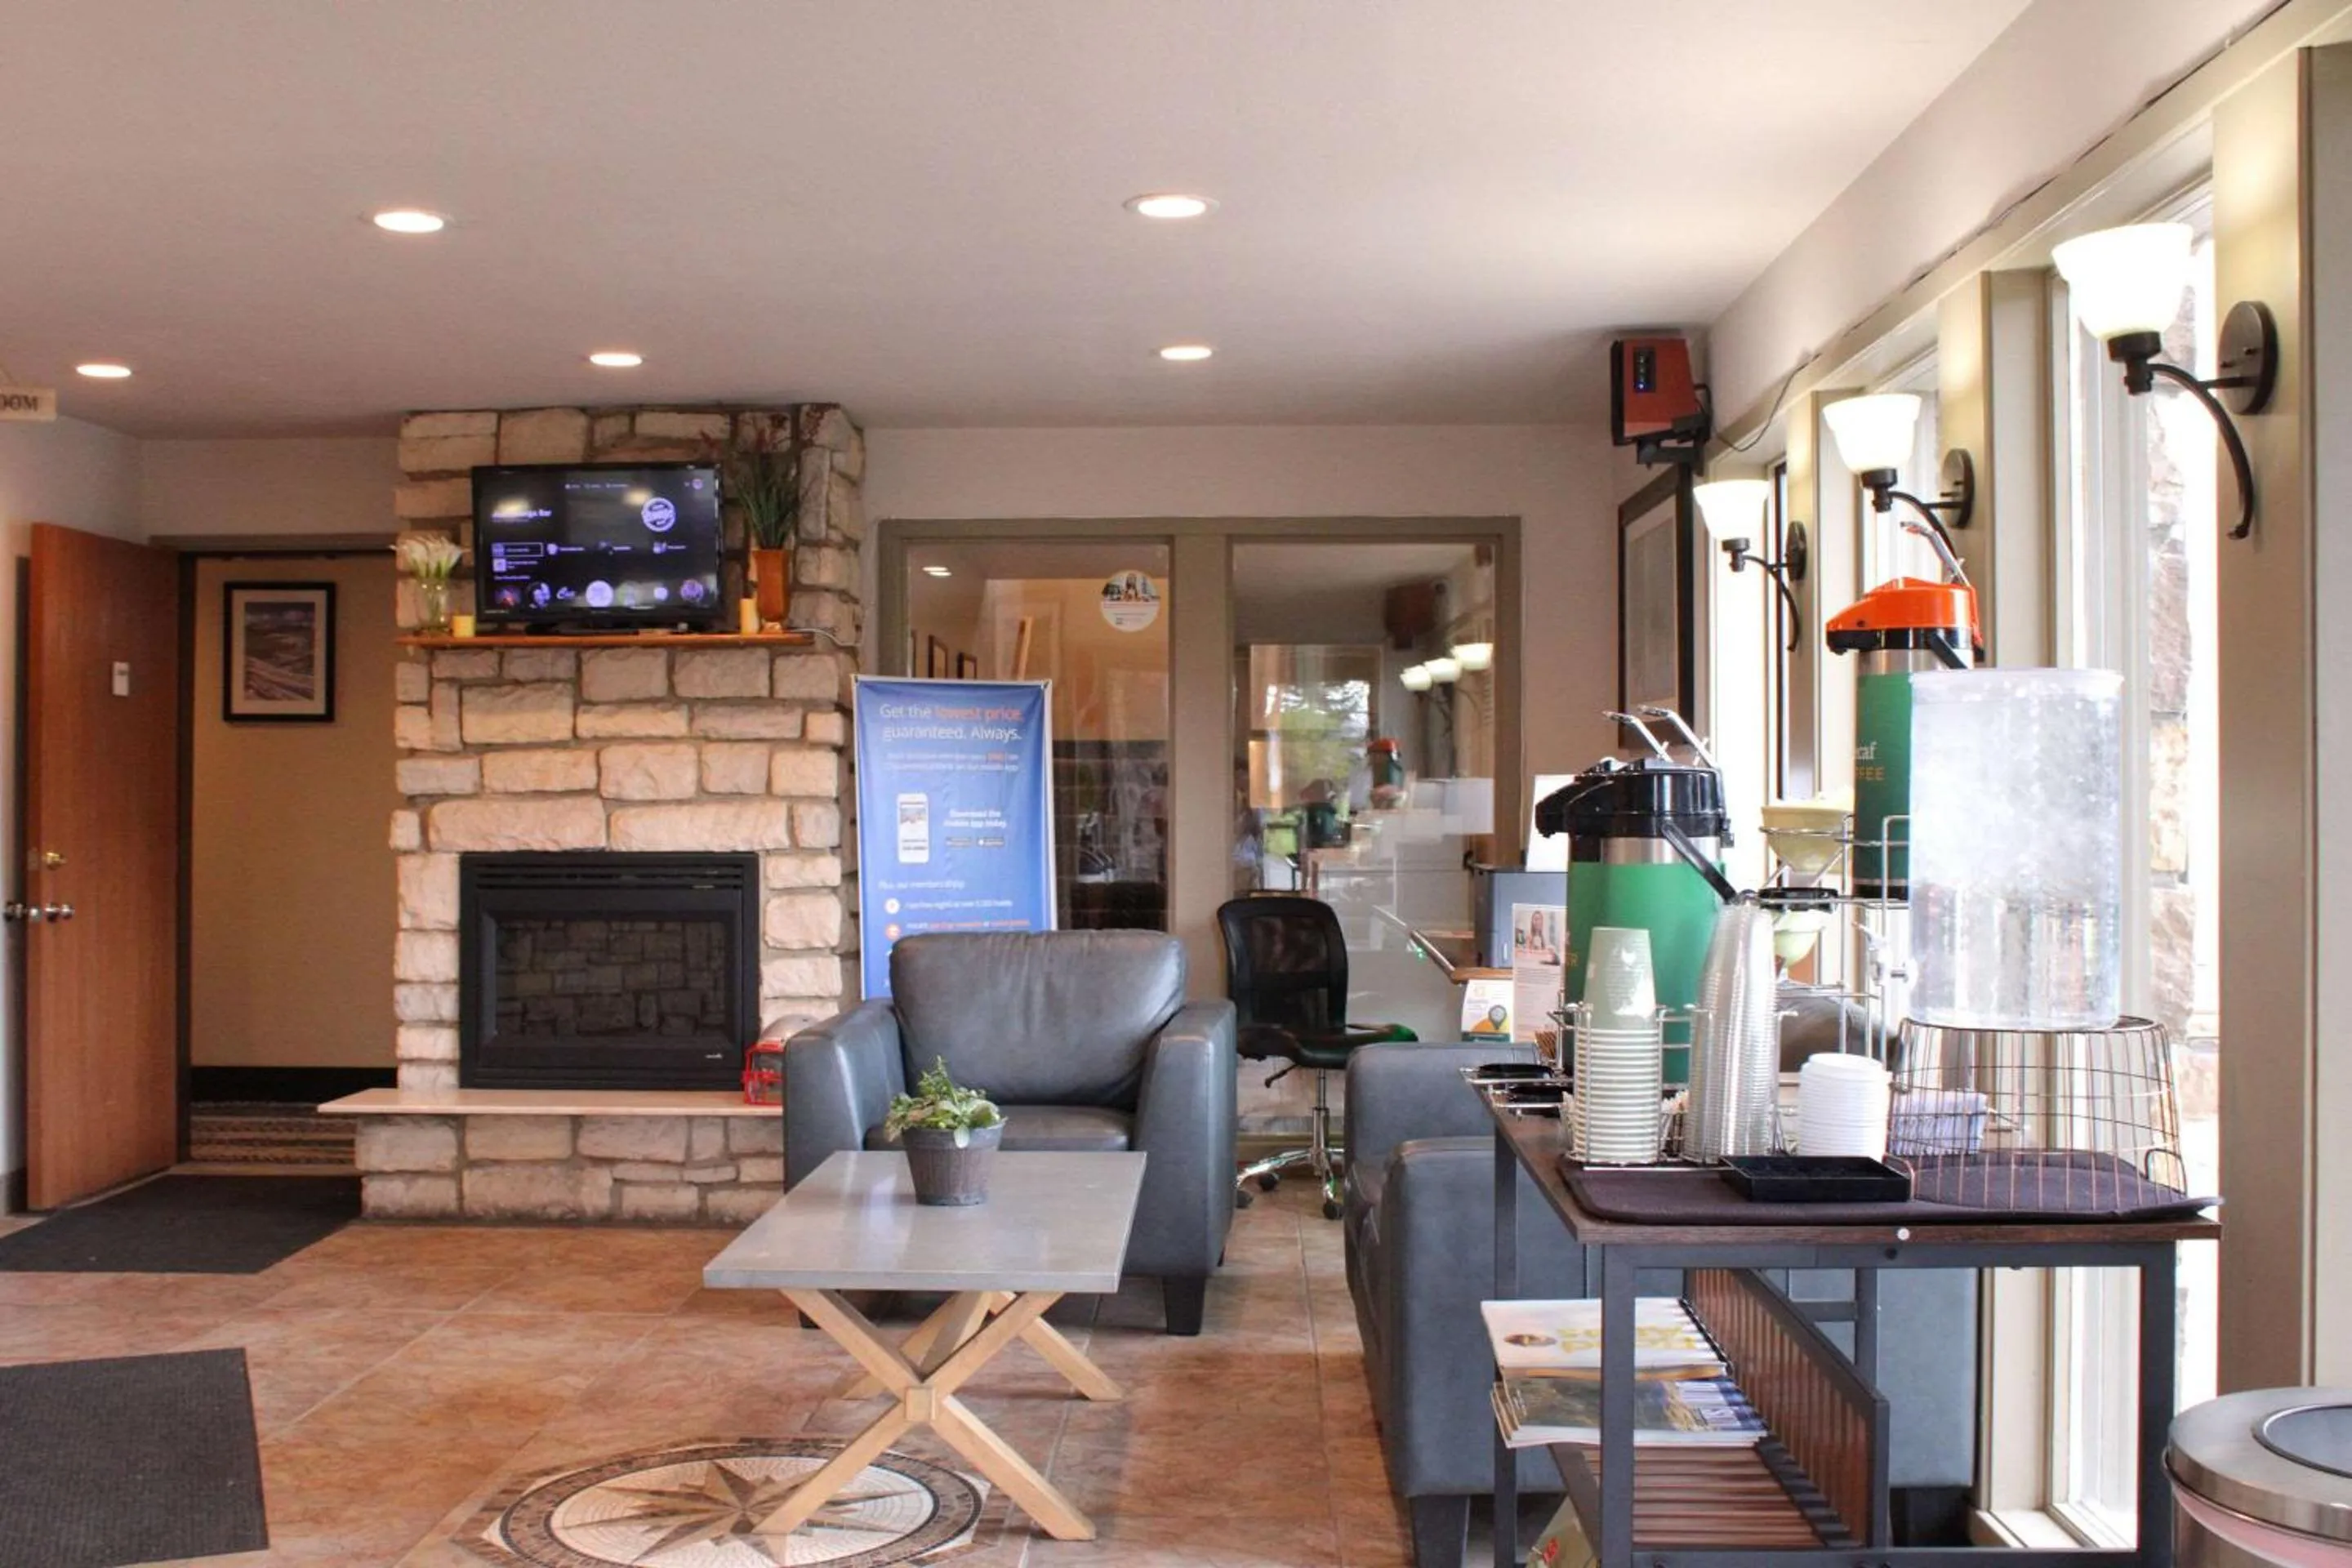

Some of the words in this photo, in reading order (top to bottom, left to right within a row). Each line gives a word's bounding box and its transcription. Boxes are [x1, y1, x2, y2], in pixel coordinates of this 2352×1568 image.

[880, 704, 904, 719] Get
[908, 704, 933, 719] the
[935, 706, 980, 720] lowest
[883, 727, 967, 742] guaranteed.
[970, 726, 1022, 743] Always.
